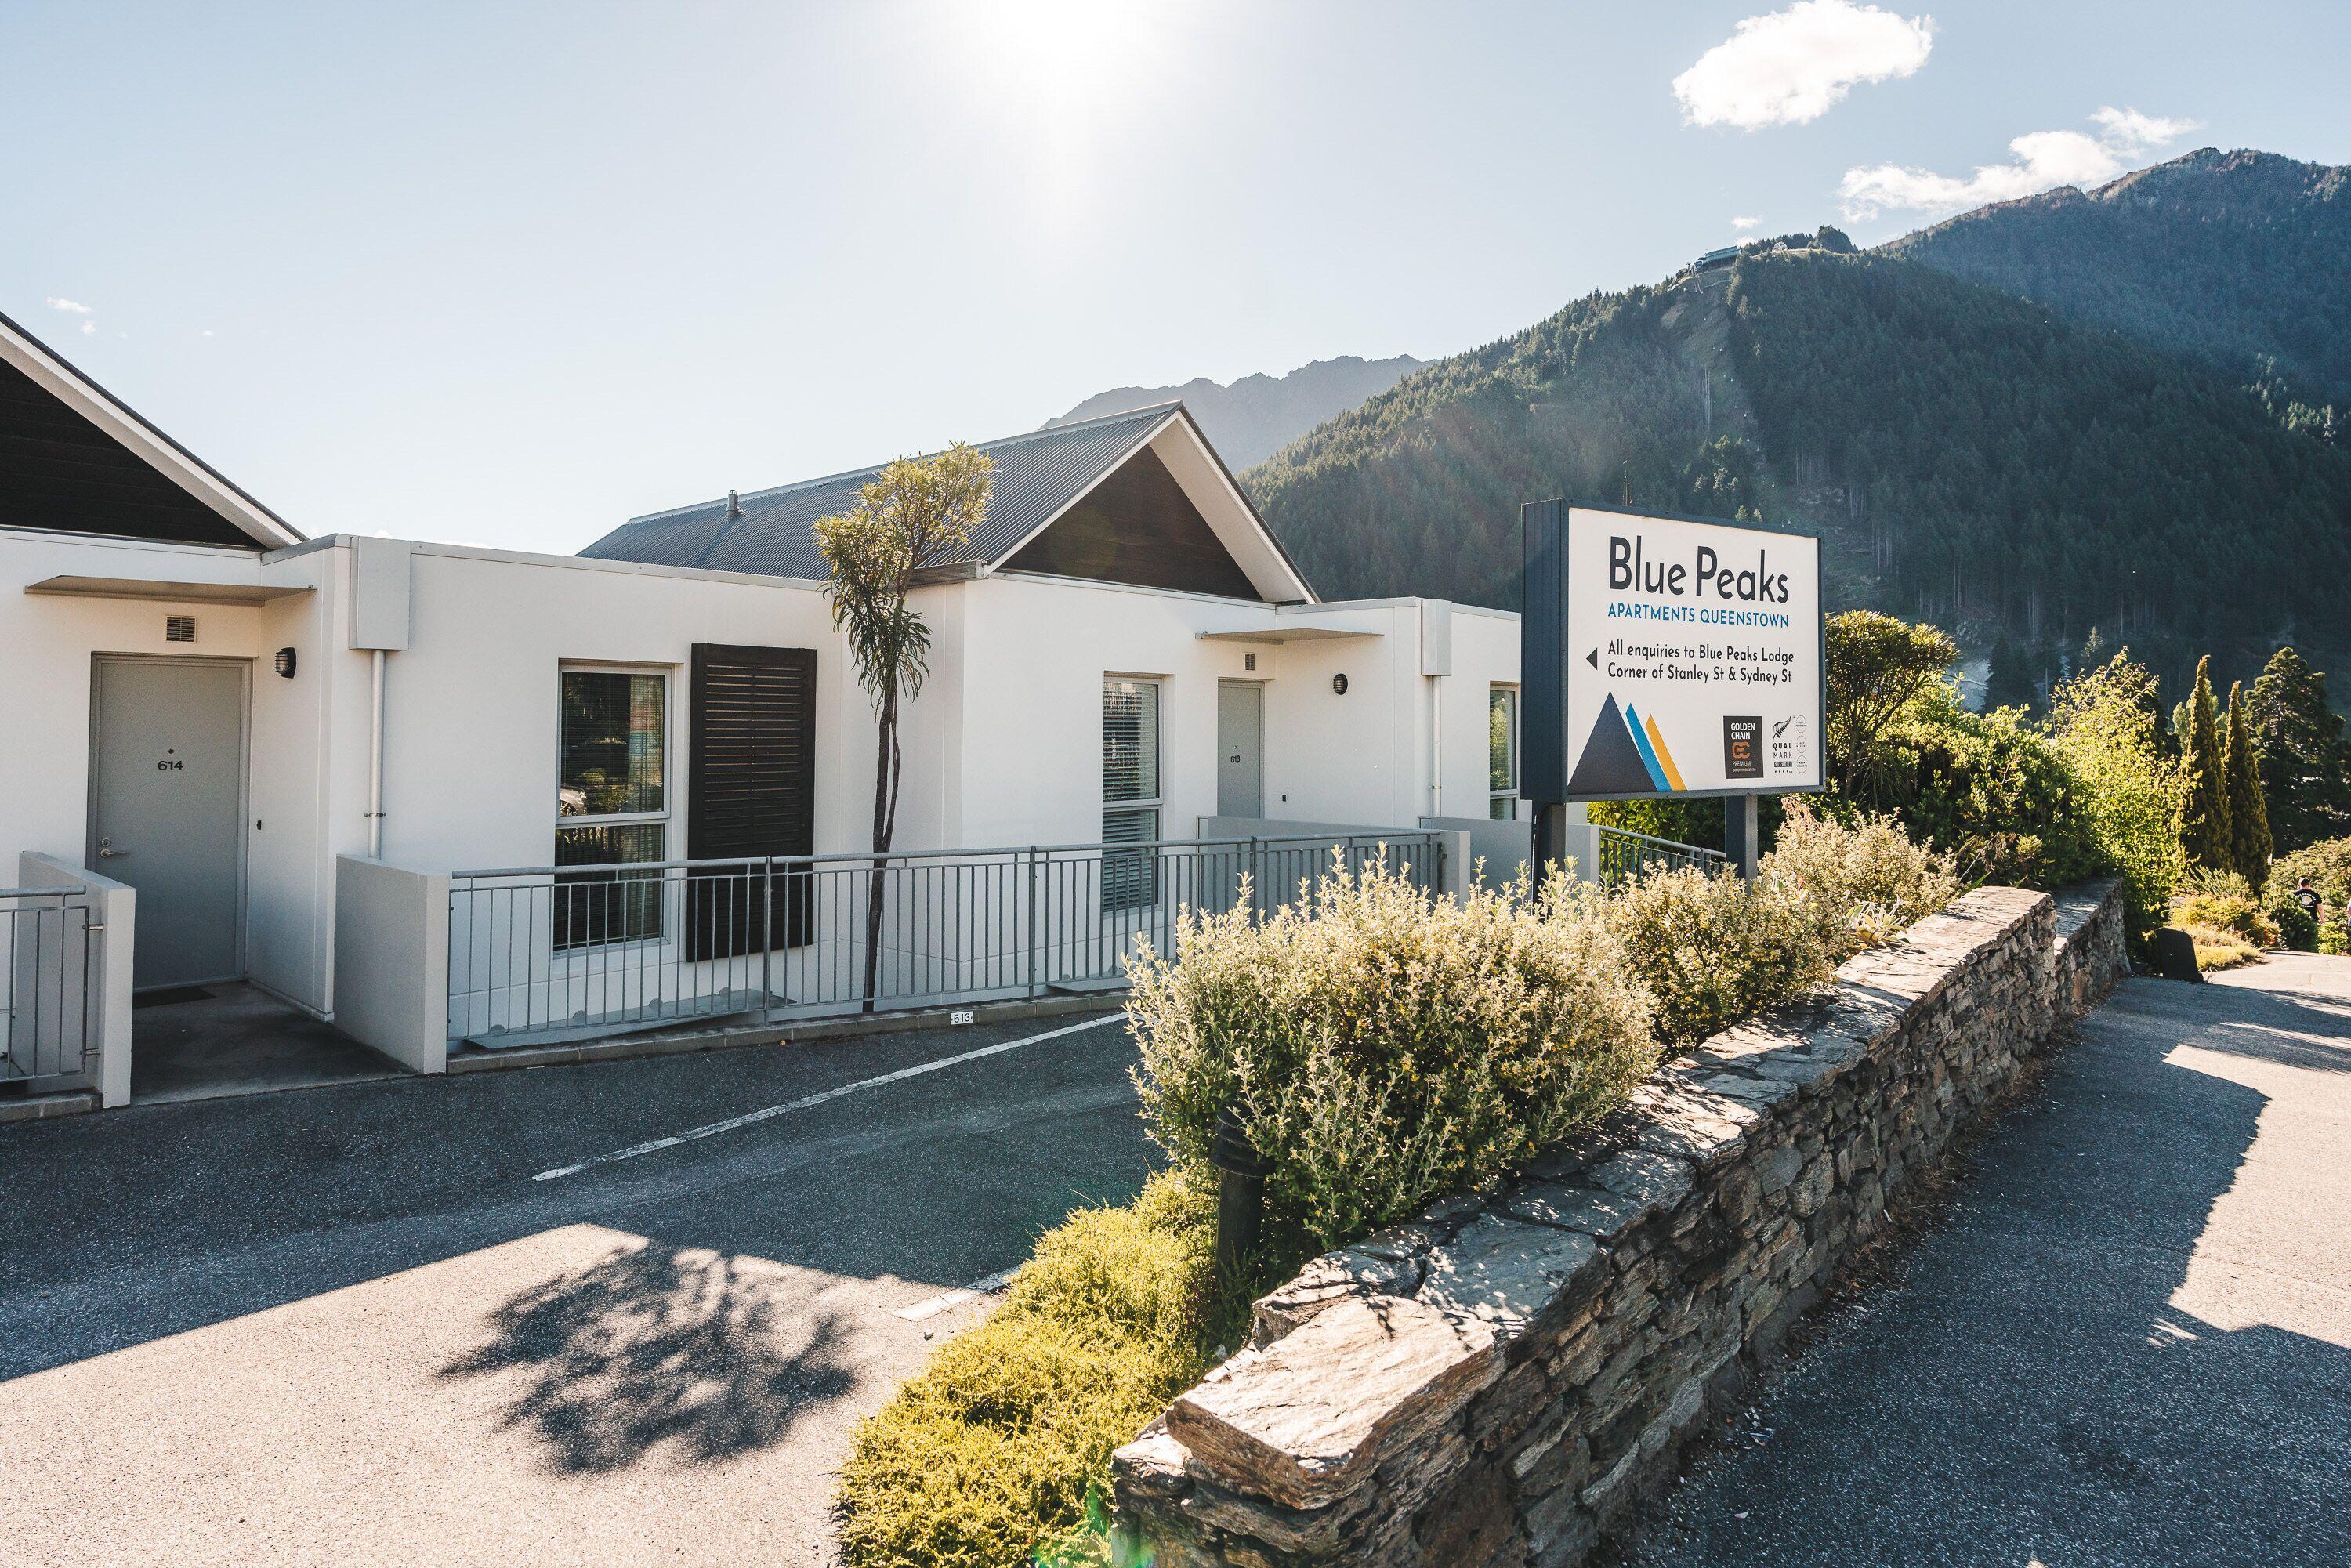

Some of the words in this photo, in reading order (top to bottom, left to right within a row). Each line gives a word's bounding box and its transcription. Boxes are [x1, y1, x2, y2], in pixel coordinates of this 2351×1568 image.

[1610, 535, 1686, 596] Blue
[1696, 545, 1789, 604] Peaks
[1608, 602, 1695, 623] APARTMENTS
[1700, 608, 1789, 628] QUEENSTOWN
[1608, 639, 1623, 655] All
[1628, 643, 1679, 661] enquiries
[1684, 645, 1695, 658] to
[1699, 643, 1722, 660] Blue
[1726, 646, 1758, 661] Peaks
[1762, 647, 1795, 666] Lodge
[1608, 661, 1647, 679] Corner
[1651, 663, 1664, 679] of
[1668, 664, 1709, 683] Stanley
[1713, 666, 1724, 681] St
[1728, 666, 1737, 681] &
[1741, 666, 1778, 686] Sydney
[1781, 668, 1792, 683] St
[1773, 742, 1791, 751] QUAL
[158, 760, 184, 771] 614
[954, 1012, 971, 1023] 613
